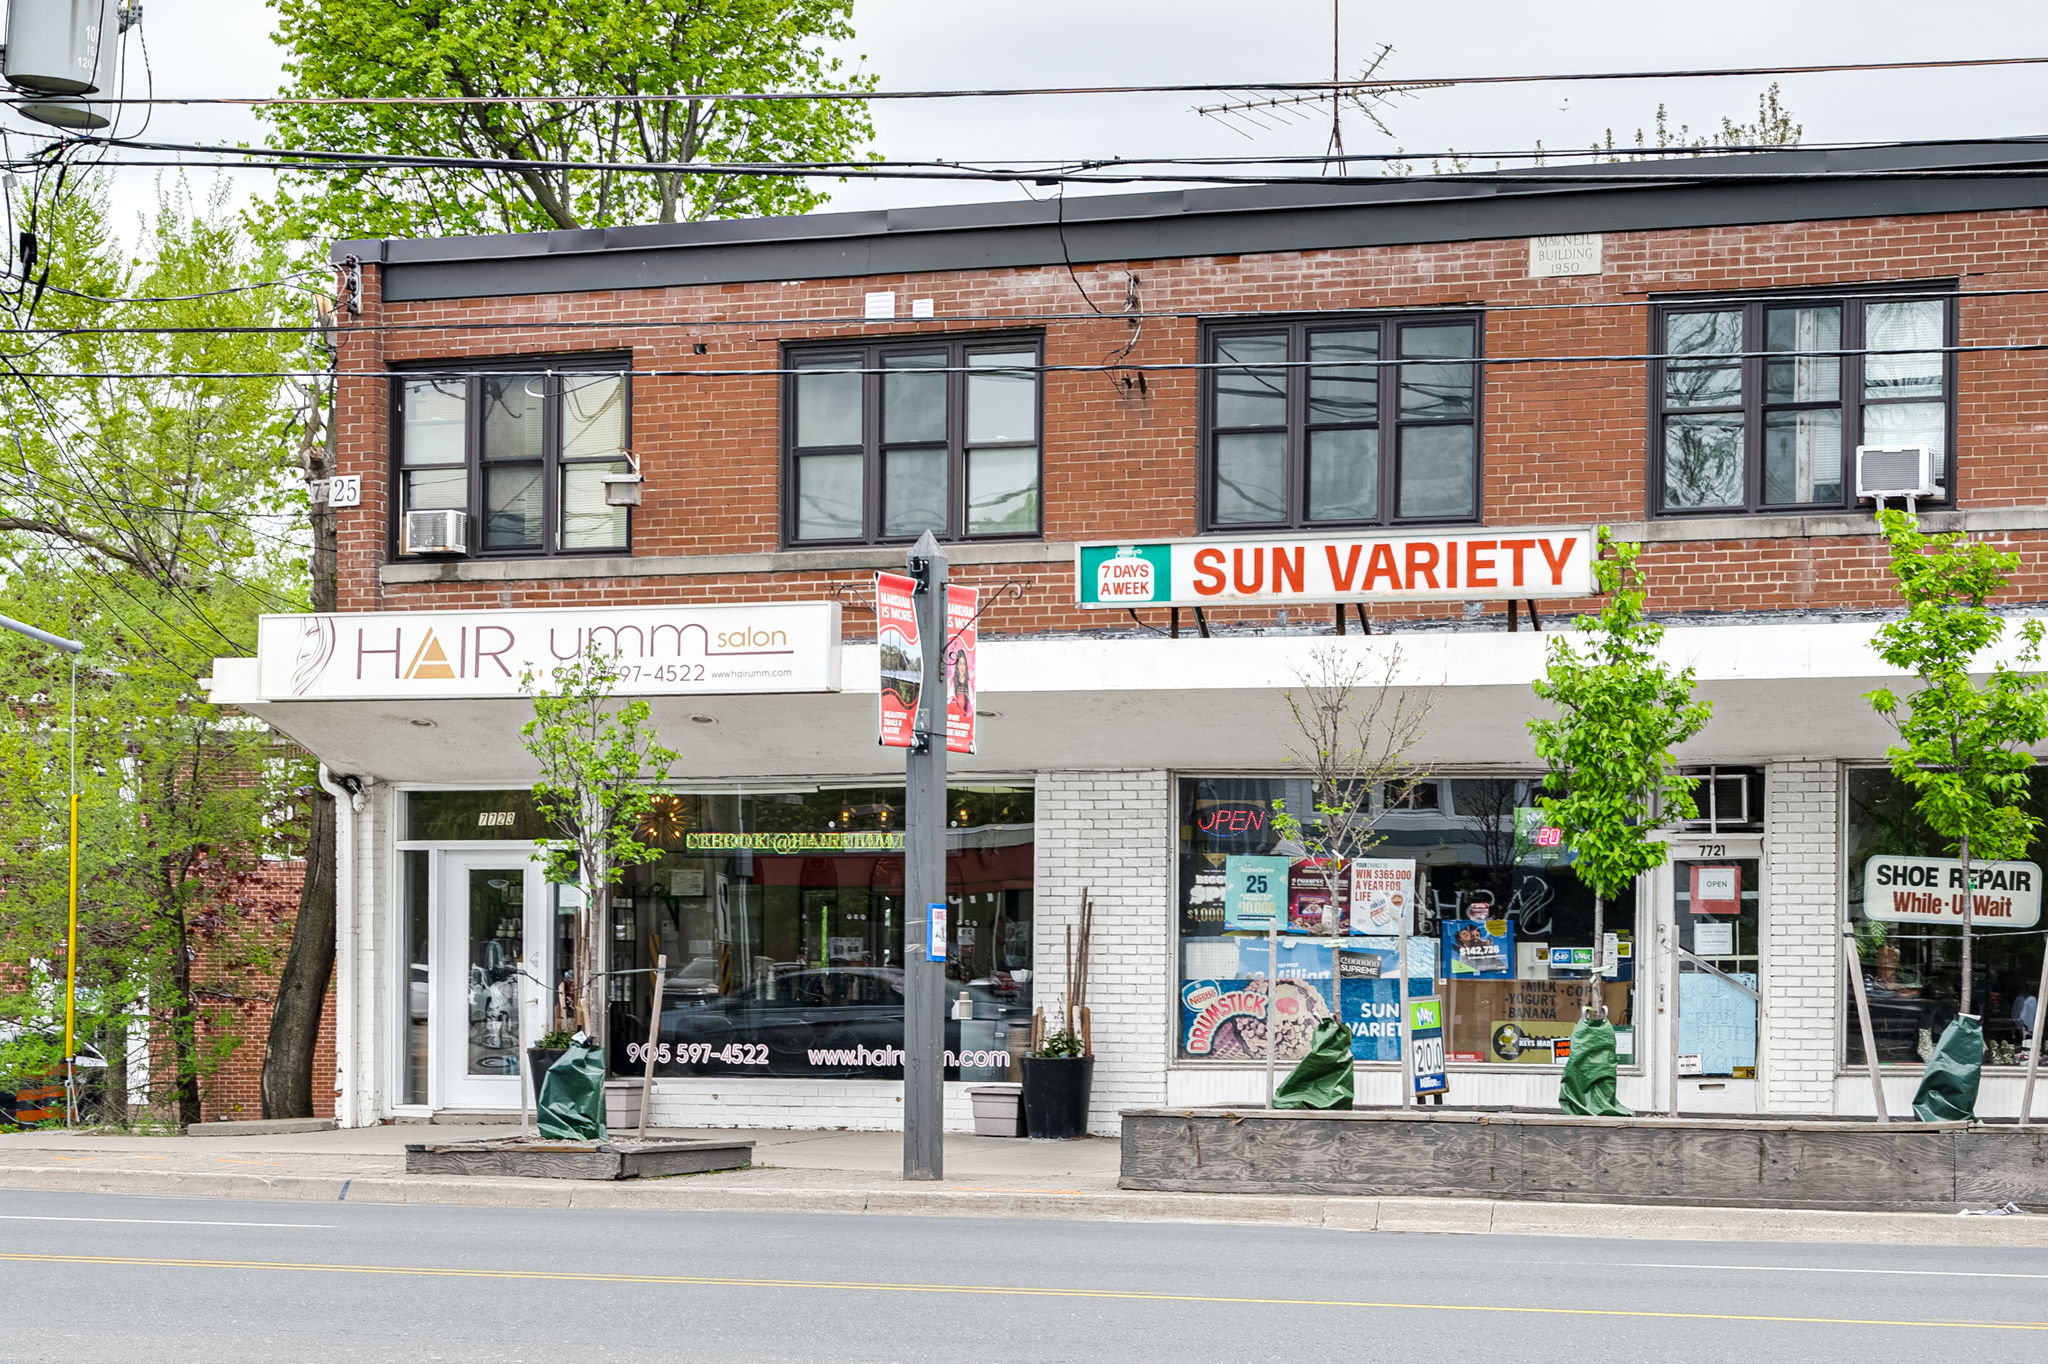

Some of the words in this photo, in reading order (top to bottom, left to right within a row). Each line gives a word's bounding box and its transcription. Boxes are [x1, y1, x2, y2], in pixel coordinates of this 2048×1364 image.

[1539, 247, 1593, 261] BUILDING
[1551, 261, 1580, 274] 1950
[1101, 565, 1111, 578] 7
[1113, 564, 1149, 578] DAYS
[1192, 546, 1305, 596] SUN
[1324, 537, 1577, 592] VARIETY
[1100, 582, 1111, 595] A
[1112, 581, 1149, 595] WEEK
[881, 605, 890, 618] IS
[891, 607, 914, 623] MORE
[955, 617, 975, 632] MORE
[717, 626, 787, 648] salon
[711, 668, 792, 679] www.hairumm.com
[480, 812, 515, 825] 7723
[1699, 845, 1726, 857] 7721
[1356, 869, 1372, 879] WIN
[1876, 864, 1939, 888] SHOE
[1949, 868, 2031, 892] REPAIR
[1246, 875, 1268, 893] 25
[1355, 881, 1361, 890] A
[1363, 881, 1383, 890] YEAR
[1385, 881, 1401, 891] FOR
[1355, 892, 1372, 901] LIFE
[1340, 964, 1379, 976] SUPREME
[1361, 1003, 1399, 1018] SUN
[1190, 994, 1266, 1051] DRUMSTICK
[626, 1043, 671, 1064] 905
[676, 1043, 769, 1065] 597-4522
